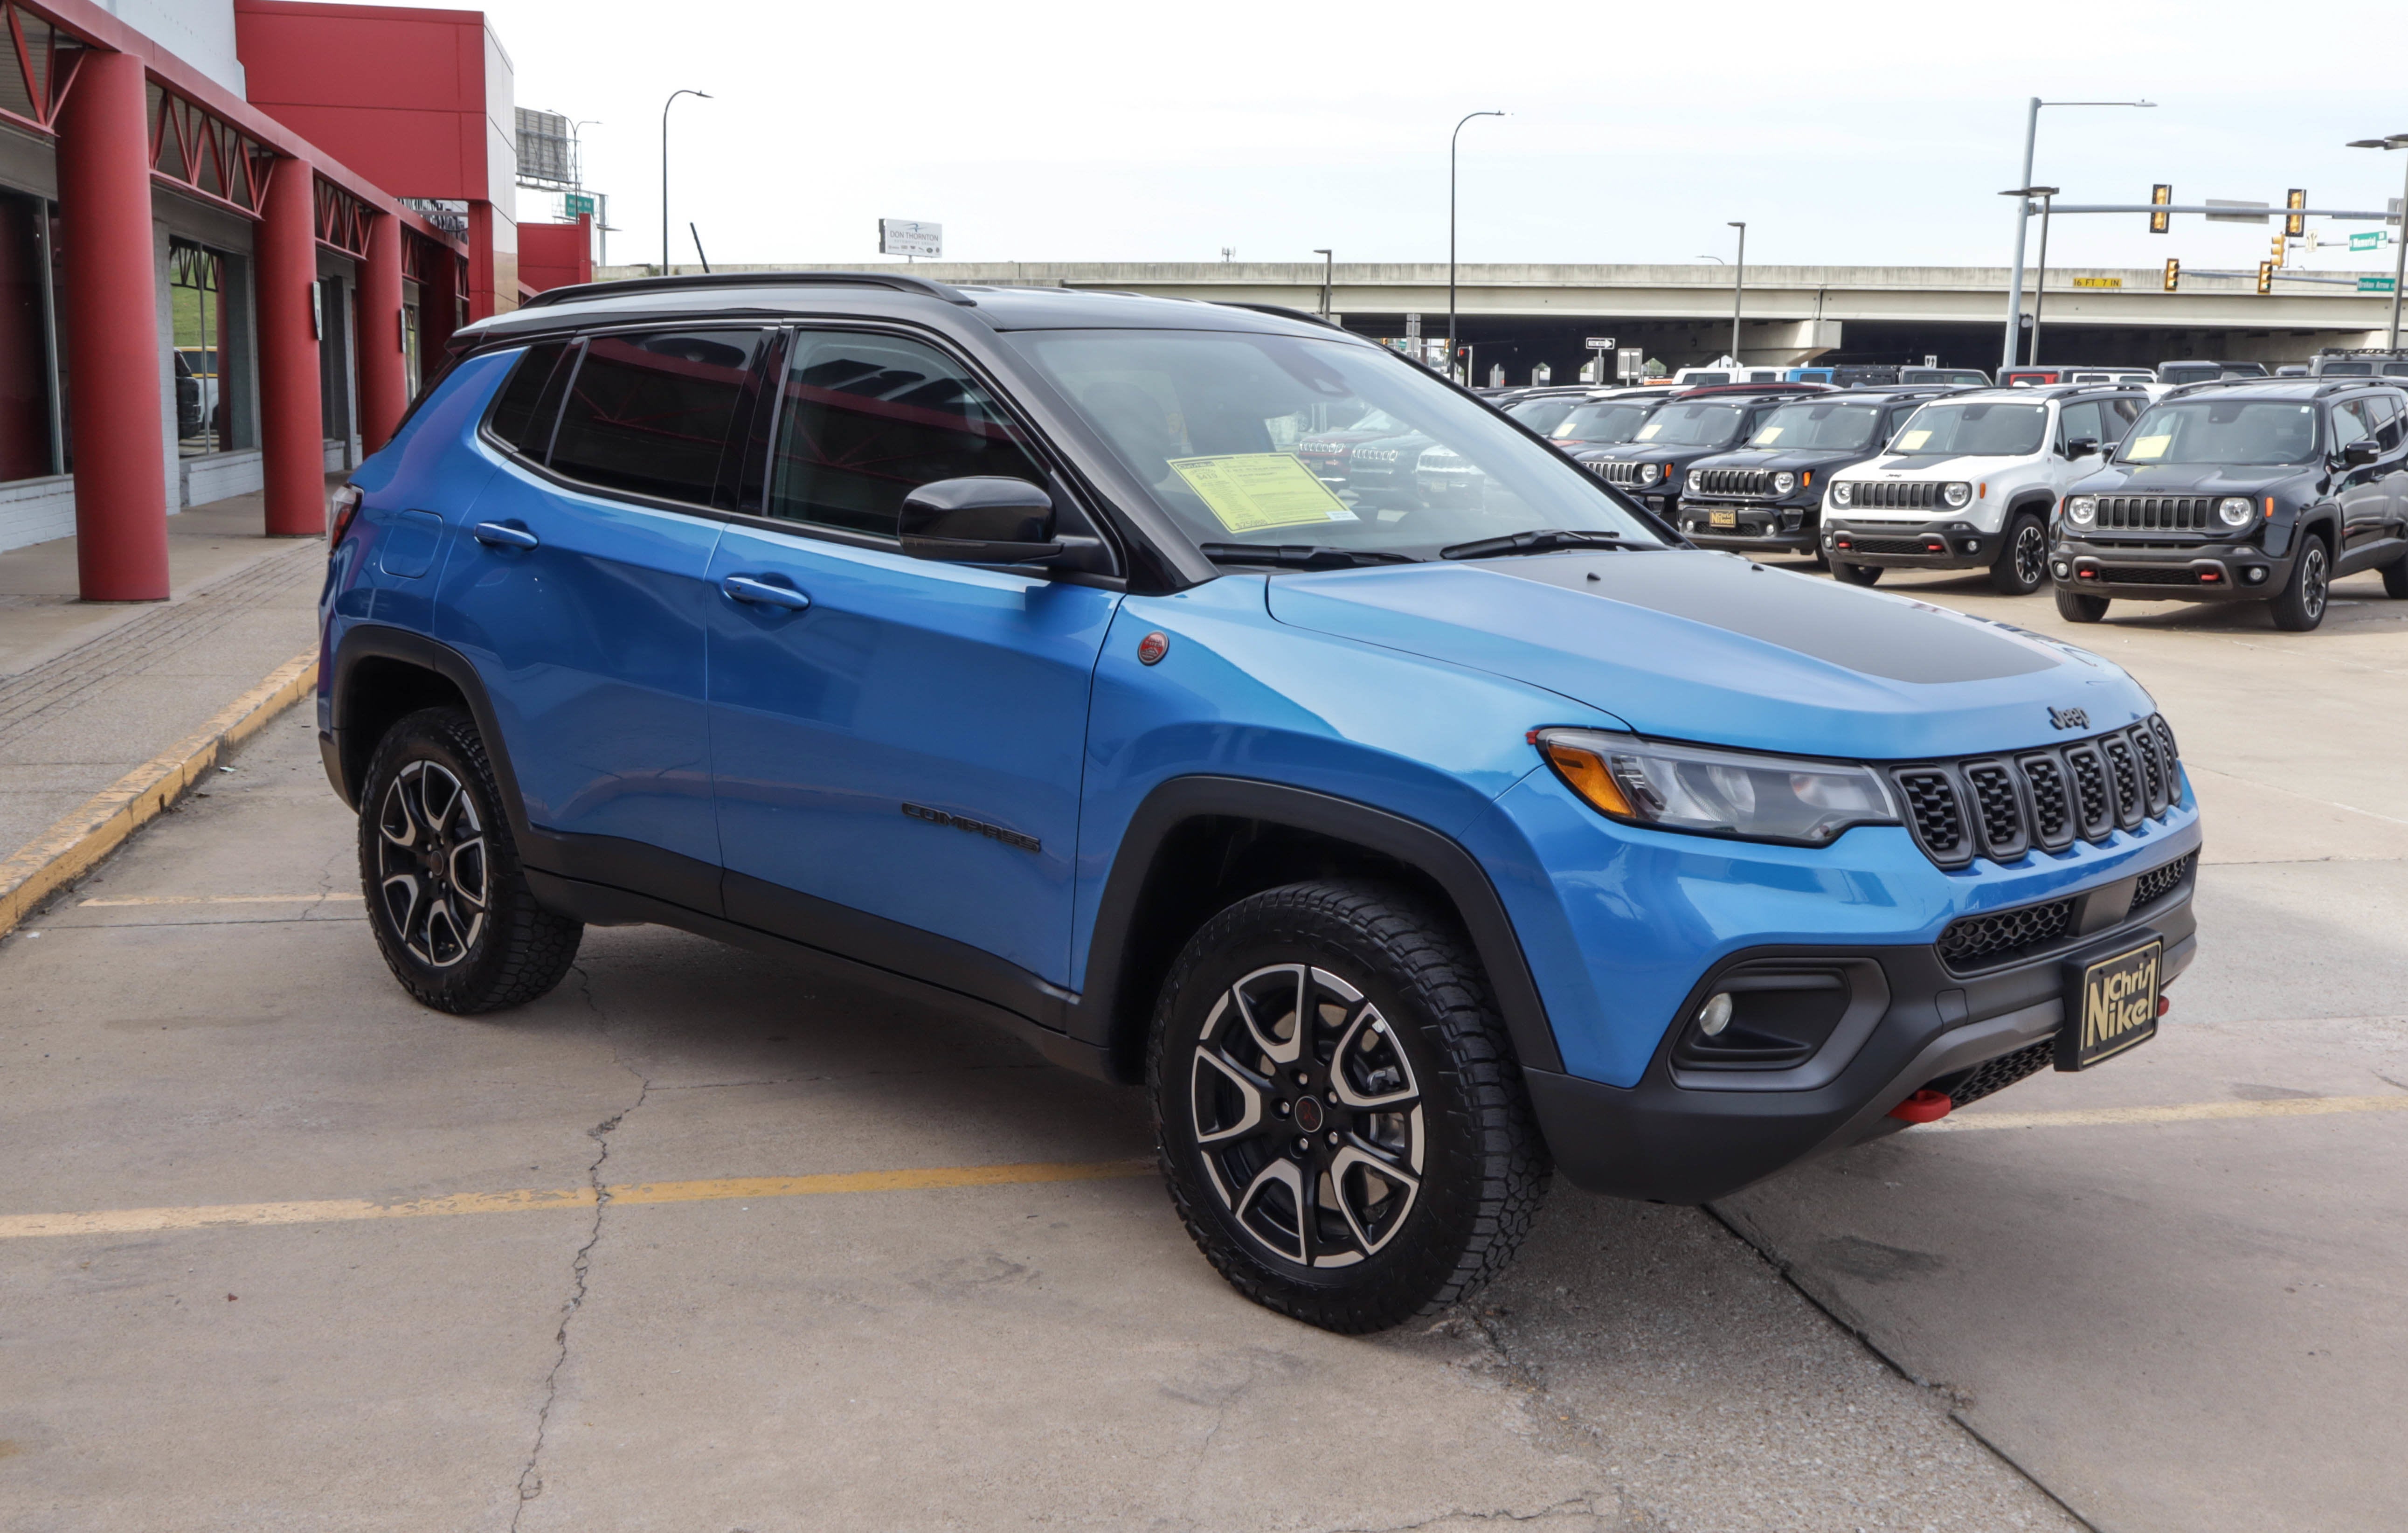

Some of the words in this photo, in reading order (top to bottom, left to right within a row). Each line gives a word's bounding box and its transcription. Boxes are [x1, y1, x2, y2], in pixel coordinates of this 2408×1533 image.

[890, 230, 904, 238] DON
[906, 231, 939, 242] THORNTON
[2353, 236, 2376, 248] Memorial
[2047, 706, 2090, 730] Jeep
[901, 801, 1042, 853] COMPASS
[2109, 963, 2152, 1001] Chris
[2086, 957, 2156, 1048] Nikel
